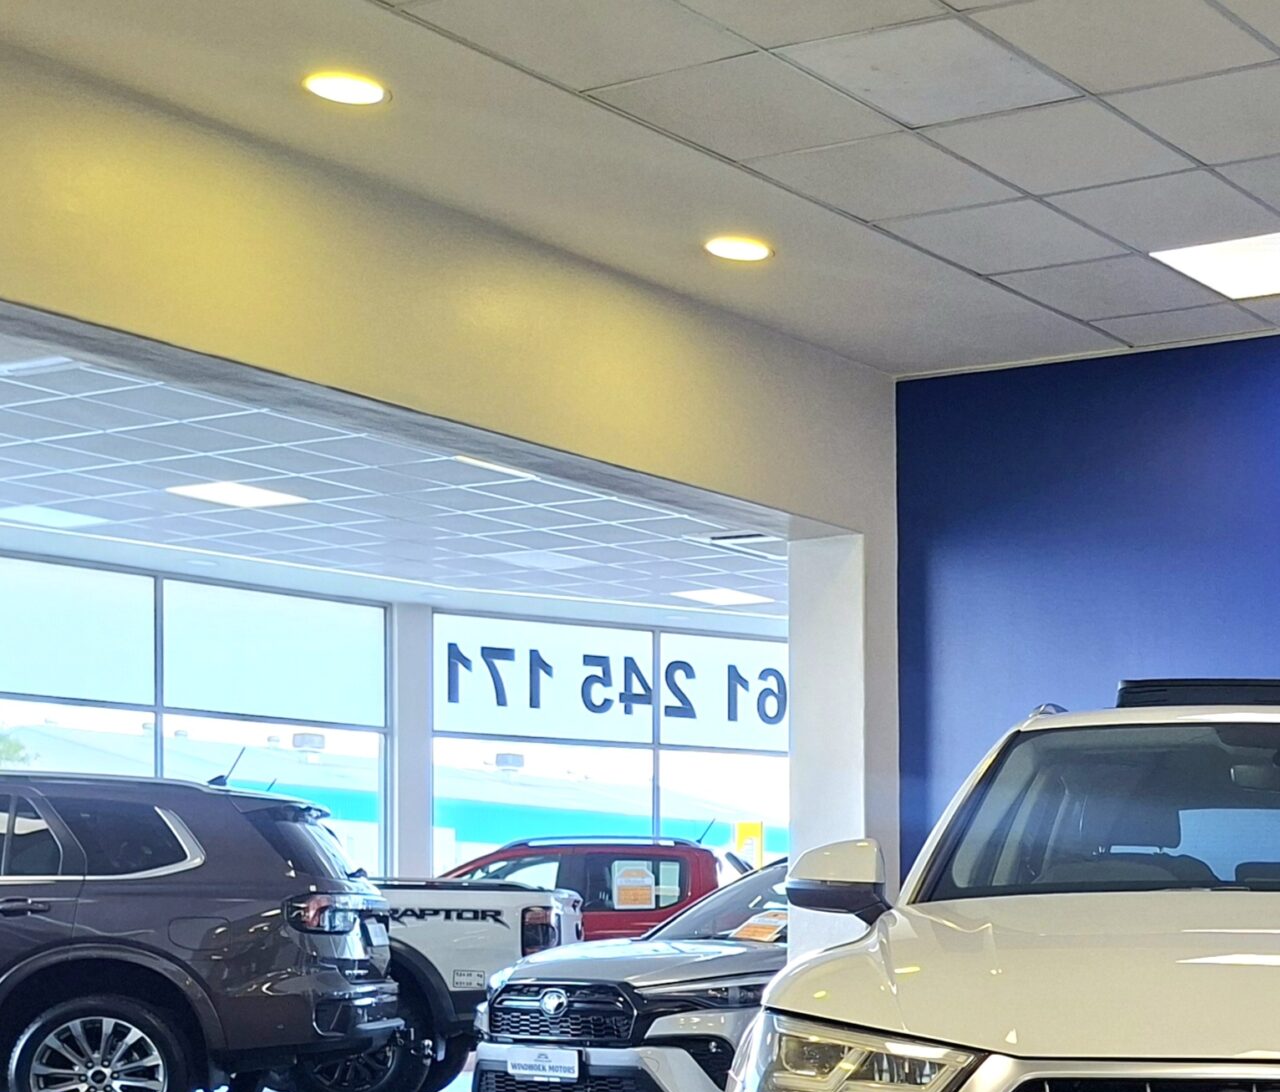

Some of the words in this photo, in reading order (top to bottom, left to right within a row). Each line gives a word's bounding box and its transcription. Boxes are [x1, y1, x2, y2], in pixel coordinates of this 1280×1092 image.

[388, 907, 511, 929] RAPTOR
[511, 1062, 547, 1073] WINDHOEK
[548, 1064, 576, 1074] MOTORS
